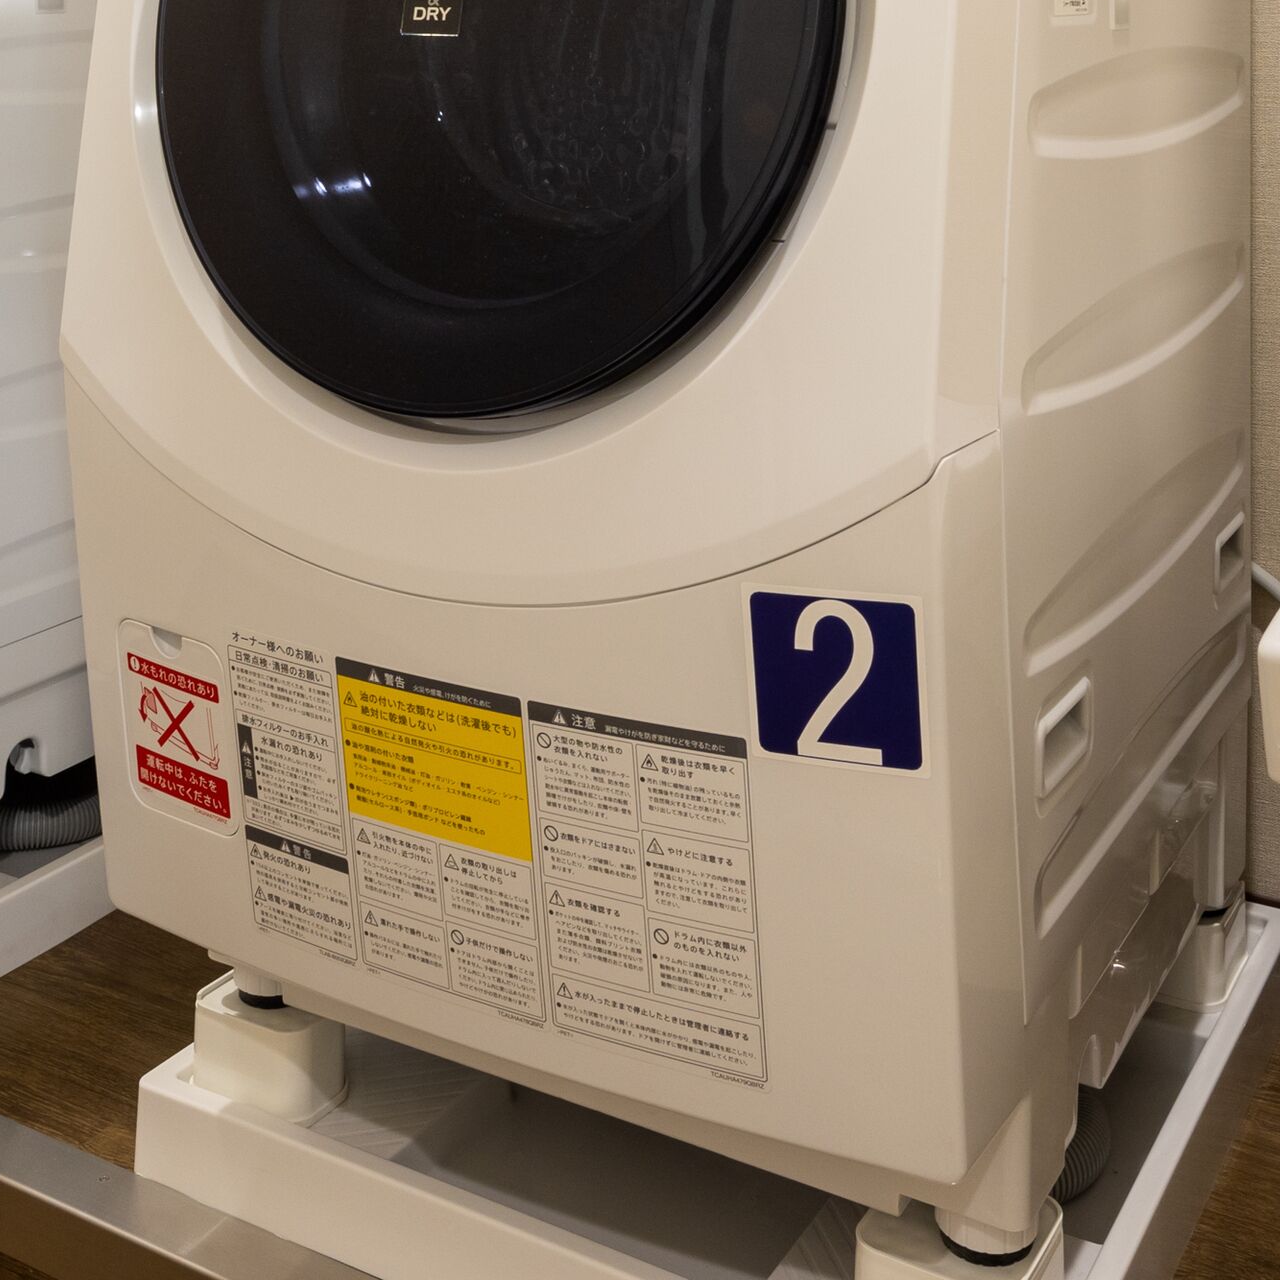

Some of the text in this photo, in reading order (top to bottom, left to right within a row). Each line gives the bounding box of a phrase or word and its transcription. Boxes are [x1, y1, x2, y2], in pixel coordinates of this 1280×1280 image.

[413, 7, 452, 21] DRY
[231, 631, 324, 665] オーナー様へのお願い
[140, 661, 216, 699] 水もれの恐れあり
[383, 672, 406, 690] 警告
[793, 598, 884, 766] 2
[241, 714, 329, 748] 排水フィルターのお手入れ
[359, 703, 437, 734] 絶対に乾燥しない
[570, 712, 597, 731] 注意
[260, 736, 323, 762] 水漏れの恐れあり
[552, 734, 624, 756] 大型の物や防水性の
[552, 744, 609, 764] 衣類を入れない
[145, 753, 218, 792] 運転中は、ふたを
[660, 753, 736, 777] 乾燥後は衣類を早く
[660, 764, 695, 780] 取り出す
[140, 768, 228, 814] 開けないでください。
[559, 831, 636, 857] 衣類をドアにはさまない
[667, 844, 733, 868] やけどに注意する
[262, 850, 312, 874] 発火の恐れあり
[566, 897, 621, 918] 衣類を確認する
[380, 918, 441, 943] 濡れた手で操作しない
[672, 928, 748, 955] ドラム内に衣類以外
[466, 937, 534, 963] 子供だけで操作しない
[672, 939, 740, 964] のものを入れない
[573, 988, 750, 1043] 水が入ったままで停止したときは管理者に連絡する
